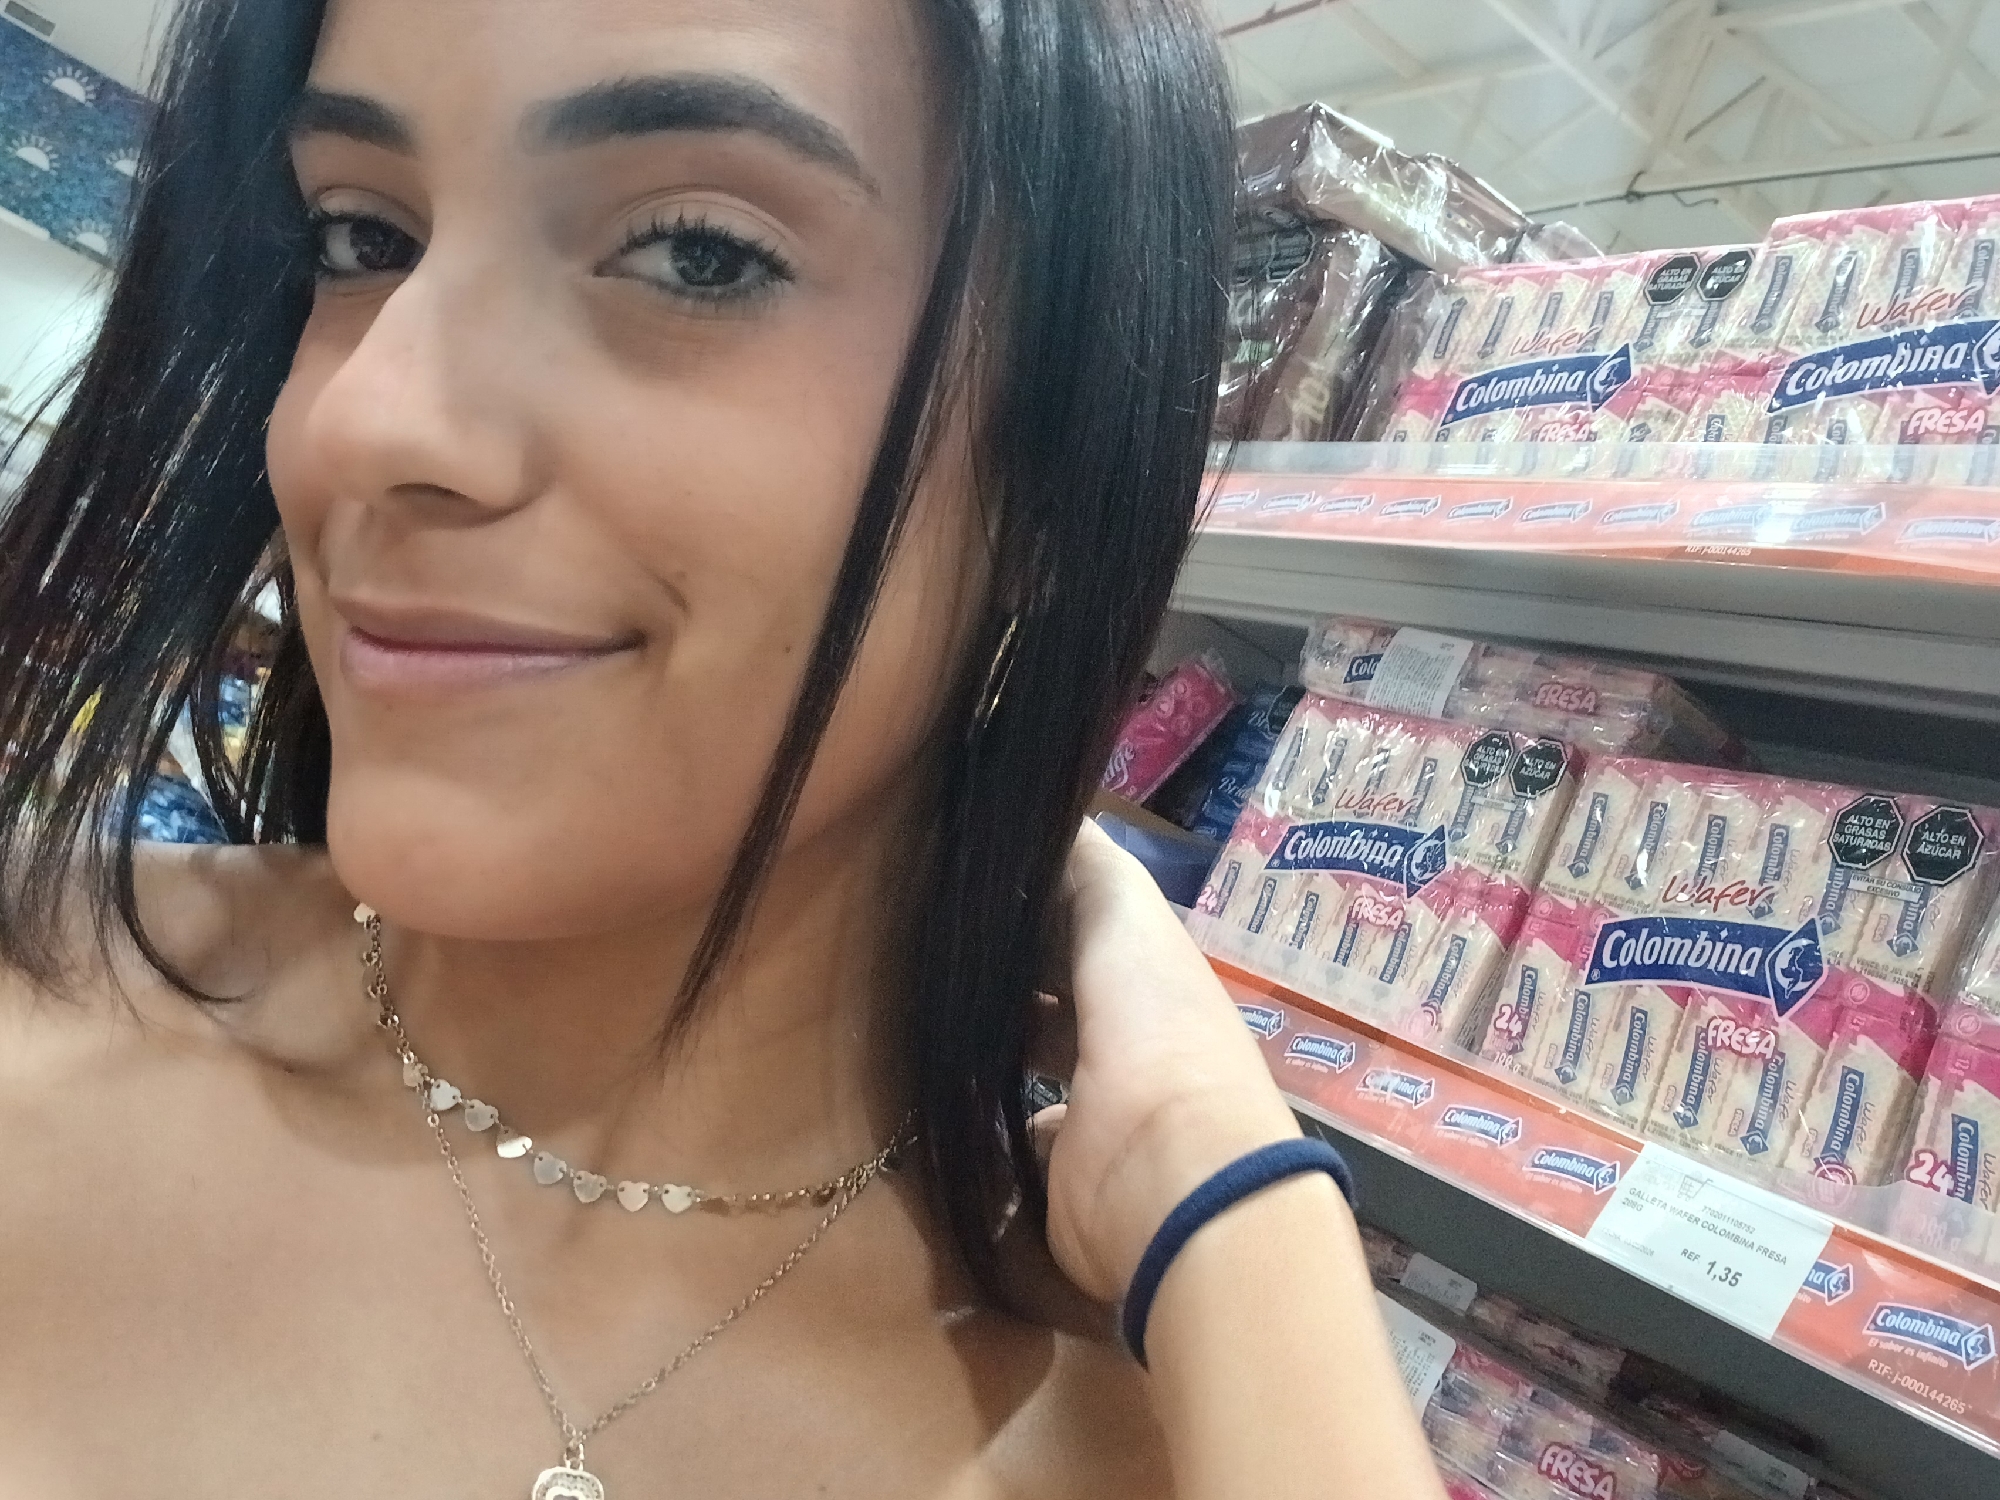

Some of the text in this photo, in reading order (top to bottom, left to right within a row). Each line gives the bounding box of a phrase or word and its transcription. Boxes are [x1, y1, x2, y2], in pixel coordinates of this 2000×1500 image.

[1856, 281, 1983, 330] Wafer
[1509, 325, 1601, 357] Wafer
[1785, 340, 1970, 396] Colombina
[1455, 363, 1584, 412] Colombina
[1538, 422, 1590, 442] FRESA
[1906, 407, 1985, 436] FRESA
[1535, 683, 1597, 714] FRESA
[1335, 788, 1414, 817] Wafer
[1844, 824, 1887, 840] GRASAS
[1845, 815, 1891, 830] ALTO EN
[1920, 830, 1967, 847] ALTO EN
[1284, 829, 1405, 869] Colombina
[1832, 832, 1892, 852] SATURADAS
[1197, 887, 1218, 912] 24
[1661, 875, 1774, 914] Wafer
[1352, 897, 1404, 932] FRESA
[1602, 928, 1764, 979] Colombina
[1495, 1004, 1523, 1037] 24
[1566, 994, 1589, 1062] Colombina
[1293, 1036, 1338, 1060] Colombina
[1622, 1012, 1646, 1082] Colombina
[1707, 1018, 1776, 1060] FRESA
[1444, 1109, 1501, 1134] Colombina
[1728, 1108, 1745, 1137] FRESA
[1830, 1072, 1860, 1153] Colombina
[1856, 1101, 1876, 1155] Wafer
[1534, 1150, 1595, 1177] Colombina
[1909, 1151, 1955, 1196] 24
[1628, 1187, 1788, 1266] GALLETA WAFER COLOMBINA FRESA
[1706, 1260, 1743, 1288] 1,35
[1876, 1308, 1962, 1347] Colombina
[1868, 1358, 1892, 1381] RIF:
[1540, 1444, 1614, 1500] FRESA
